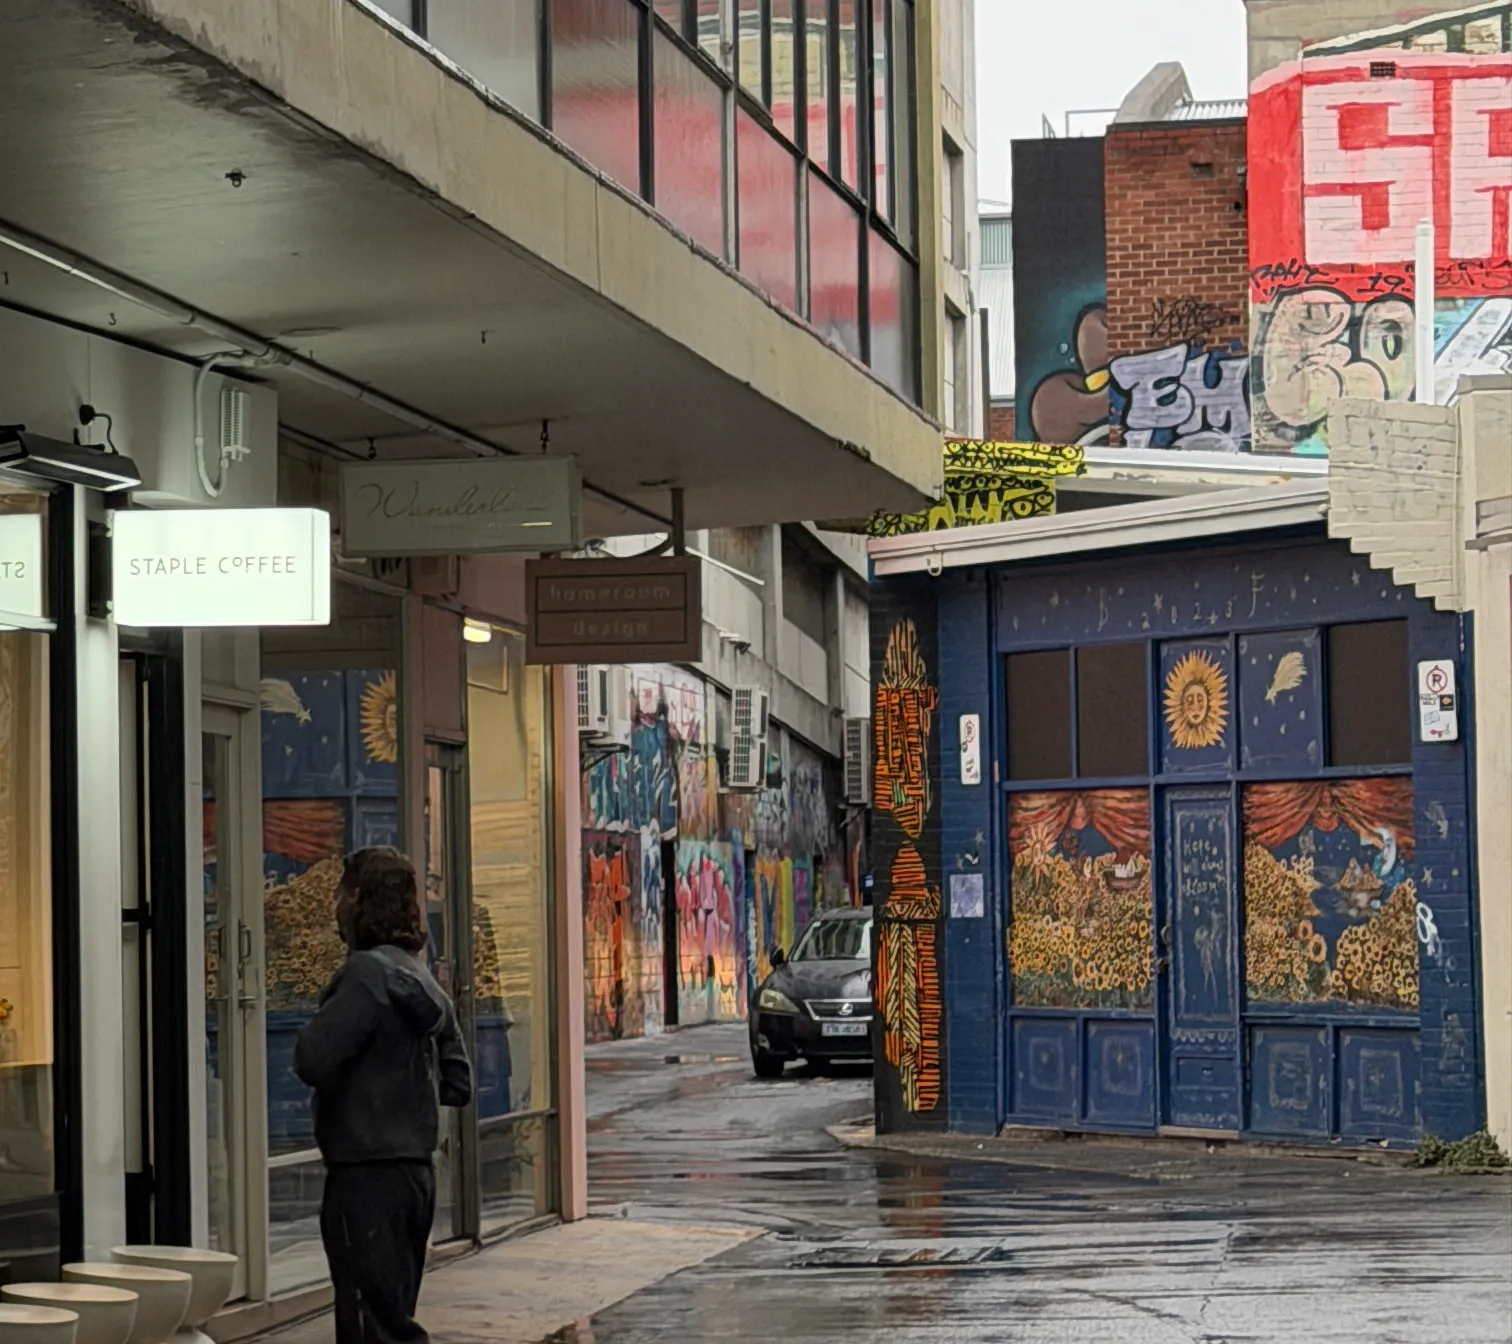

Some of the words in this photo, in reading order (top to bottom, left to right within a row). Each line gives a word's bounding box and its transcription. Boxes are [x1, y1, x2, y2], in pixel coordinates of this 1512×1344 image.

[129, 556, 208, 576] STAPLE
[217, 555, 297, 575] COFFEE
[549, 583, 671, 602] homeroom
[573, 619, 649, 639] design
